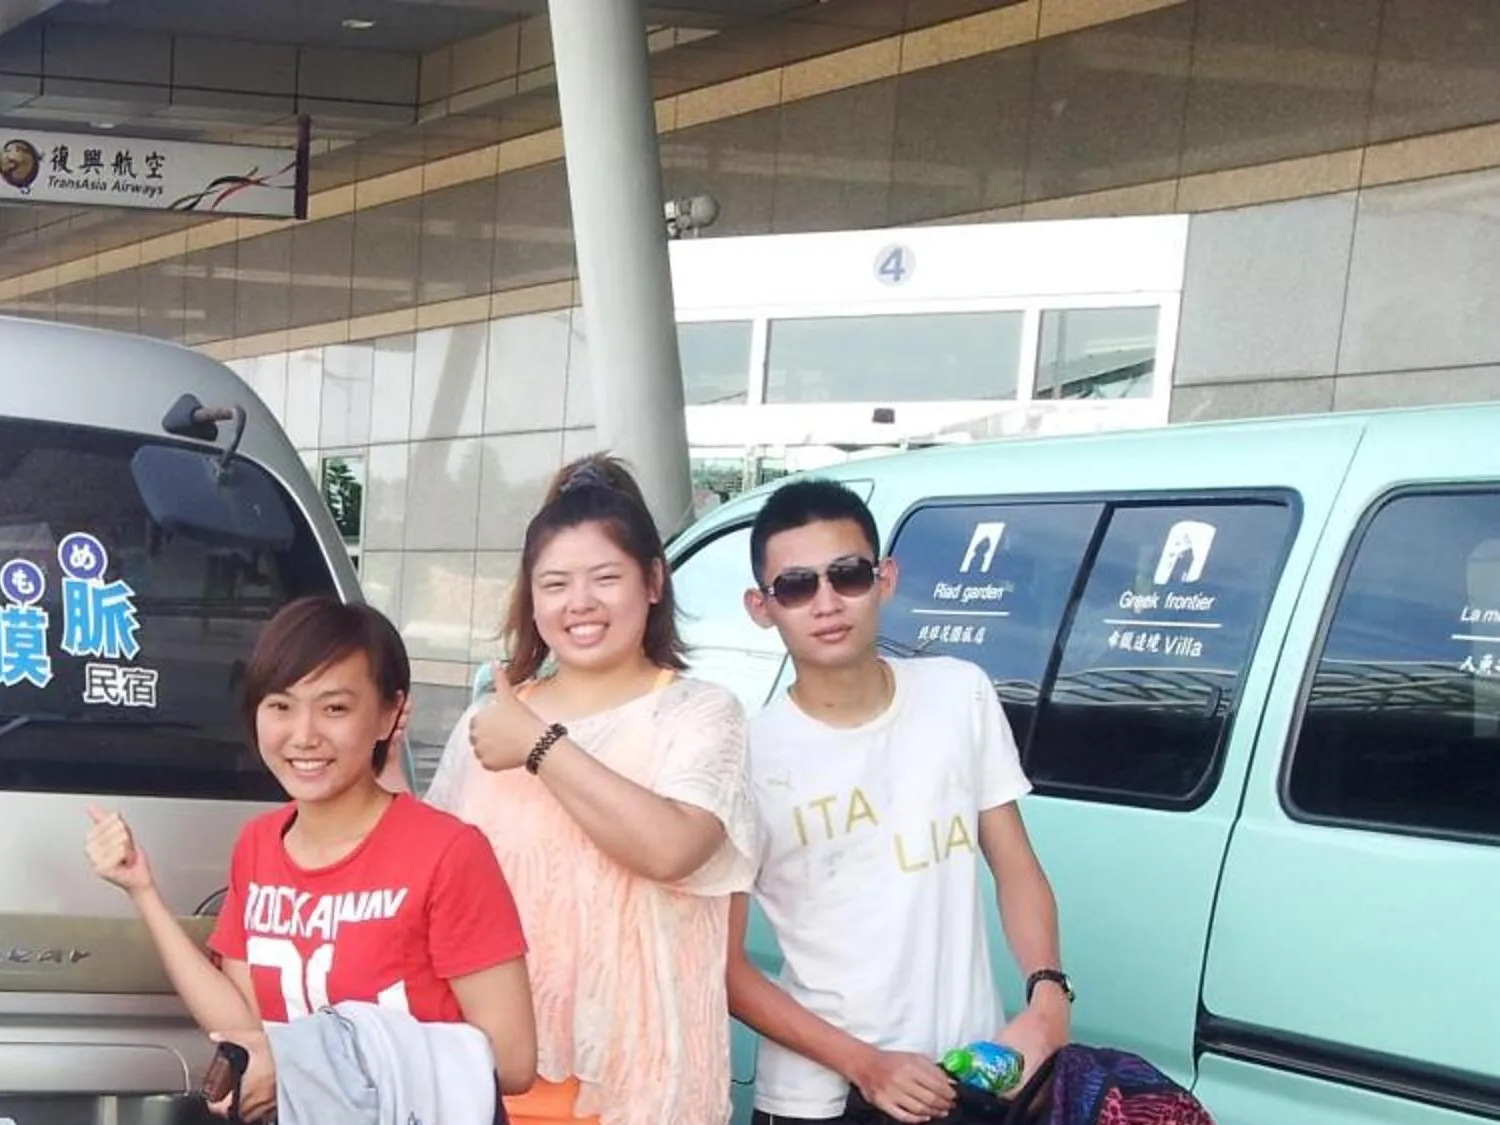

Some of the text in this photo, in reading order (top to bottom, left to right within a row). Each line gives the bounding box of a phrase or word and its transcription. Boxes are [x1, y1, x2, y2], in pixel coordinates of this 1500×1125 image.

[50, 145, 166, 179] 復興航空
[48, 175, 164, 198] TransAsia Airways
[879, 247, 906, 282] 4
[961, 584, 1004, 602] garden
[1165, 592, 1216, 611] frontier
[1164, 634, 1203, 657] Villa
[84, 664, 158, 706] 民宿
